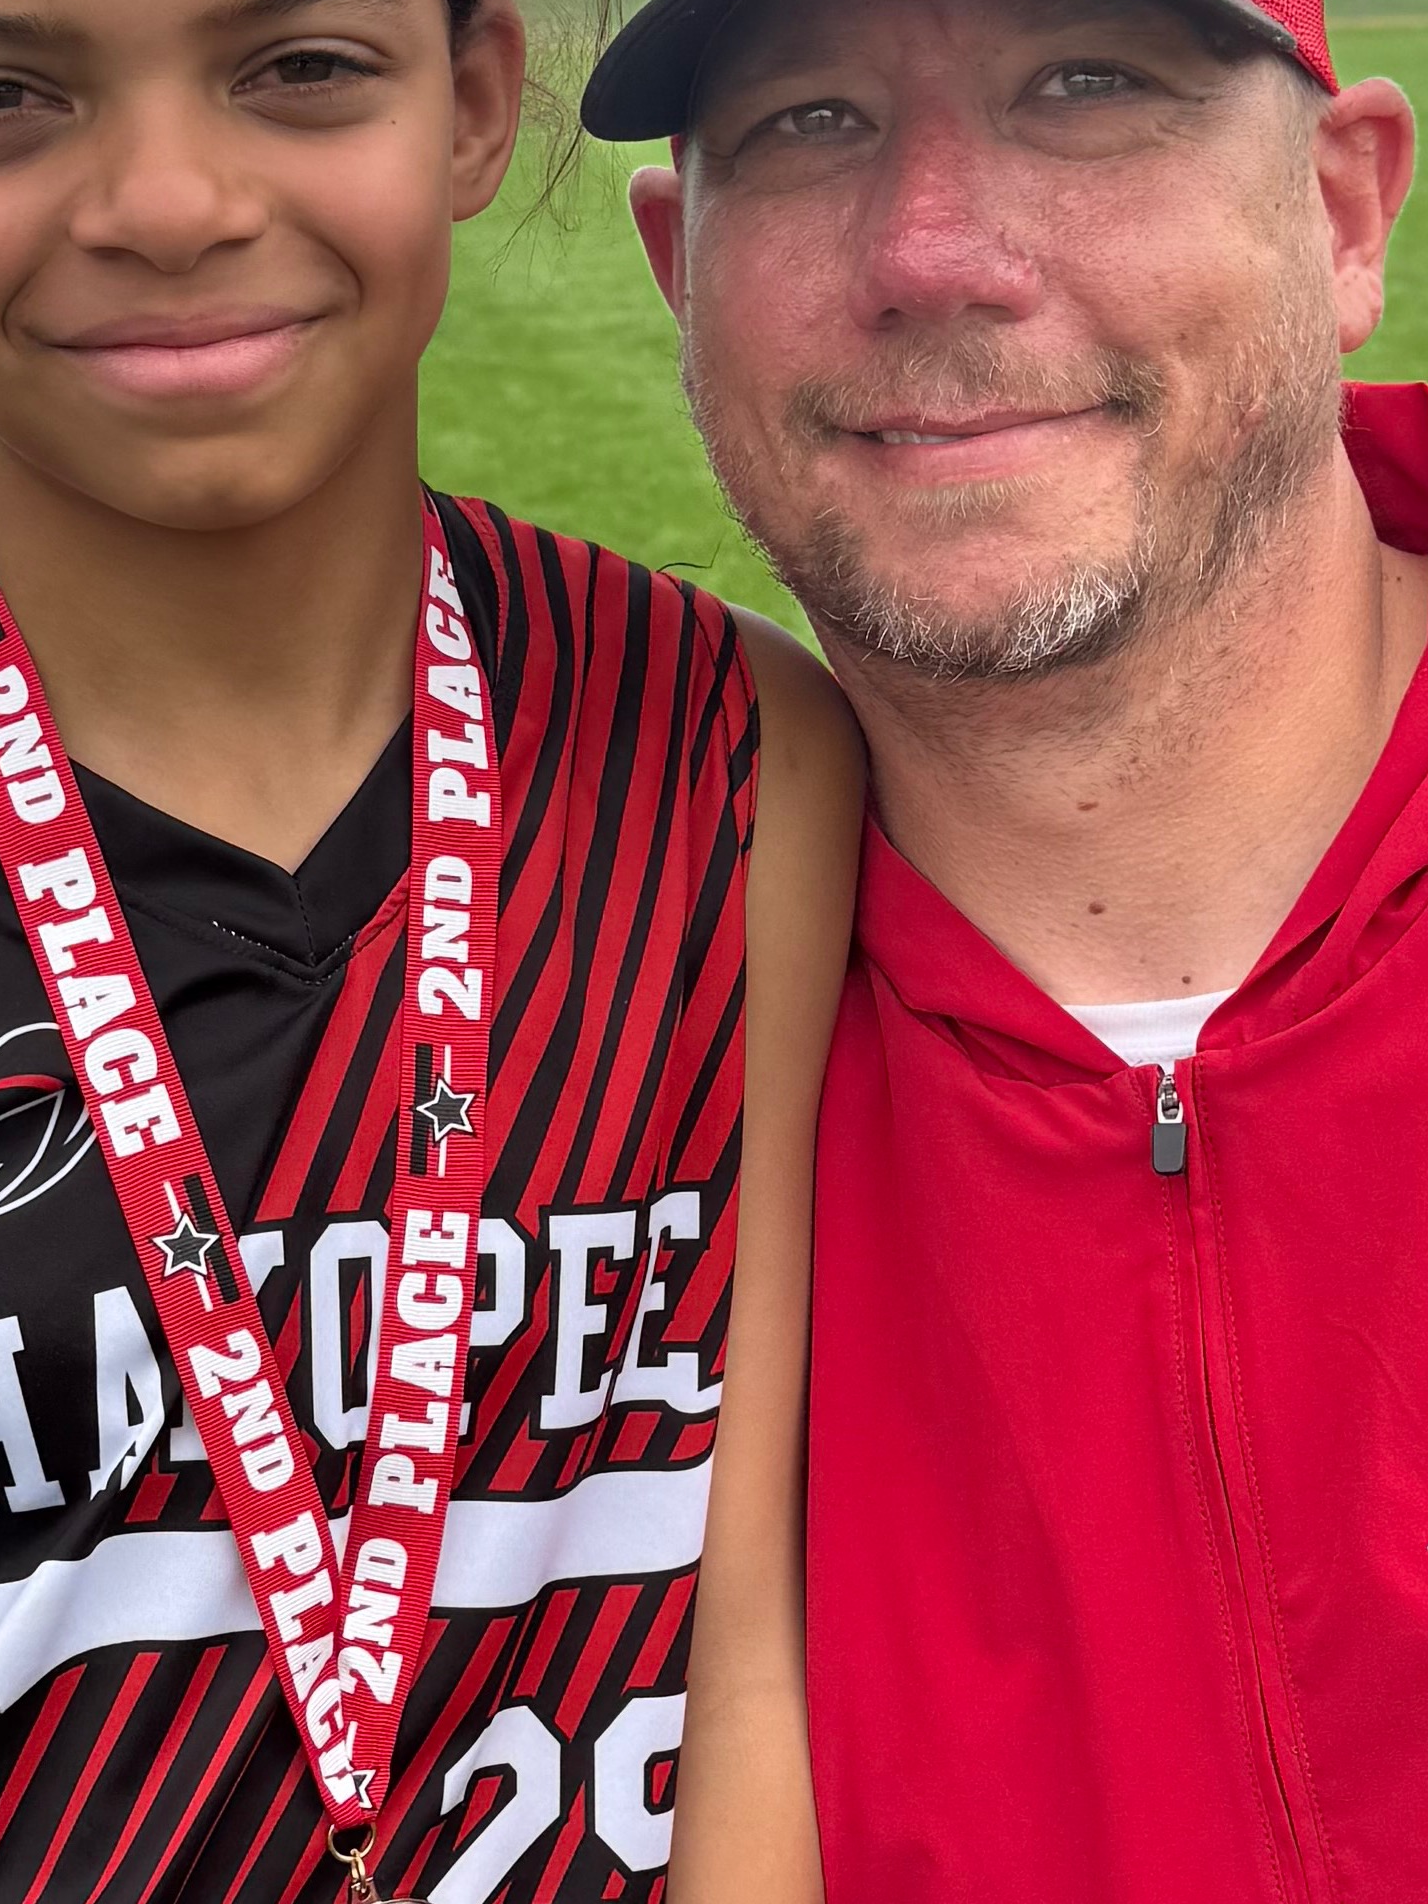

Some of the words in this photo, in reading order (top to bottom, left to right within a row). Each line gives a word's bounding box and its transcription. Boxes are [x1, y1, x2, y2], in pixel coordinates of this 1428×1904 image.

[428, 545, 491, 828] PLACE
[17, 846, 183, 1159] PLACE
[419, 855, 482, 1021] 2ND
[187, 1328, 295, 1492] 2ND
[367, 1209, 470, 1514] PLACE
[337, 1537, 404, 1705] 2ND
